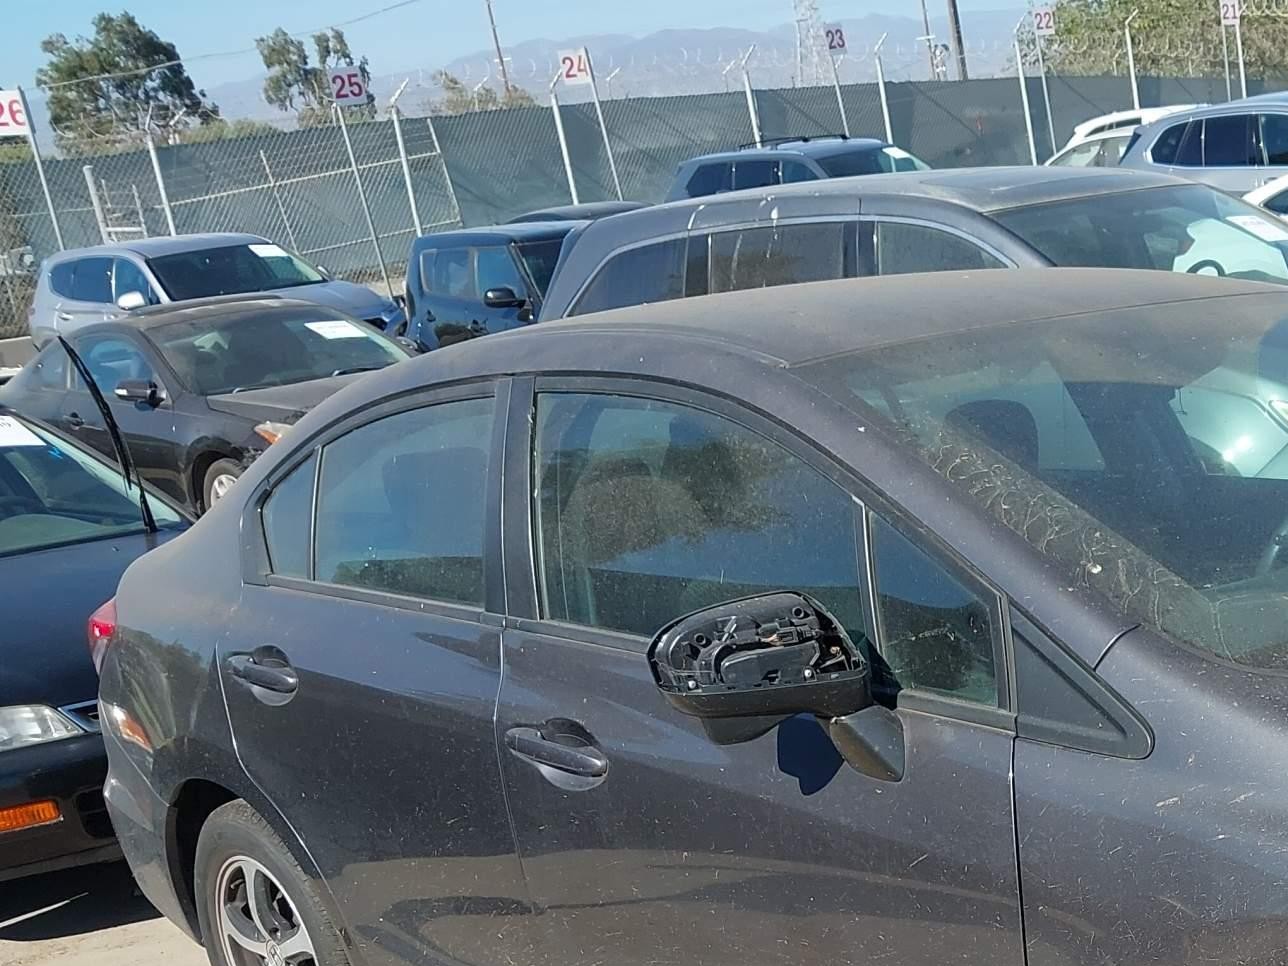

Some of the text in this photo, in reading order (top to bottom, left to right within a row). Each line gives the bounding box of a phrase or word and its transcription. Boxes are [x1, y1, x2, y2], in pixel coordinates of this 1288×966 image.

[1034, 11, 1053, 30] 22
[1223, 3, 1238, 20] 21
[826, 28, 845, 50] 23
[562, 54, 589, 79] 24
[331, 72, 363, 99] 25
